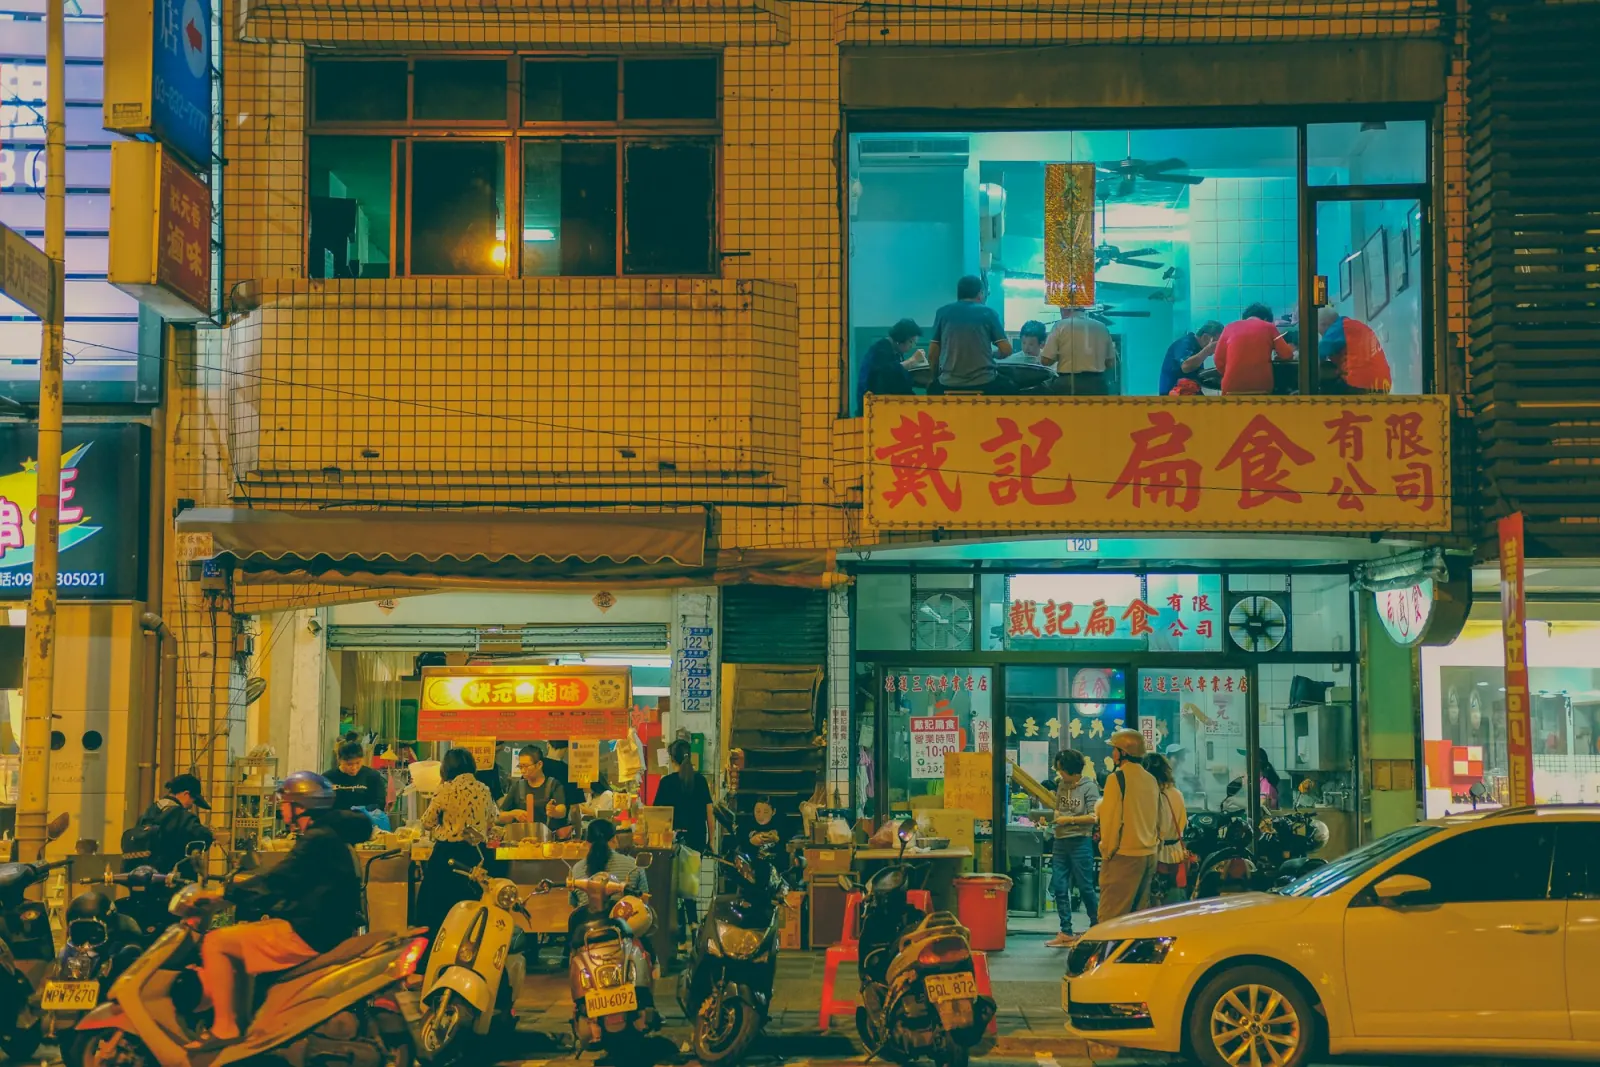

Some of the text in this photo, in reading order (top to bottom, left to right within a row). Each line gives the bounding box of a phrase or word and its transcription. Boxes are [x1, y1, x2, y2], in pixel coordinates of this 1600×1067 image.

[1324, 410, 1434, 462] 有限
[875, 410, 1315, 512] 戴記扁食
[1326, 462, 1434, 512] 公司
[1072, 538, 1092, 550] 120
[1166, 593, 1213, 613] 有限
[1008, 598, 1160, 638] 戴記扁食
[1168, 618, 1213, 638] 公司
[684, 636, 702, 648] 122
[679, 659, 697, 671] 122
[682, 677, 701, 690] 122
[885, 675, 988, 693] 花蓮三代專業老店
[1143, 675, 1249, 693] 花蓮三代專業老店
[682, 698, 701, 711] 122
[914, 733, 956, 745] 營業時間
